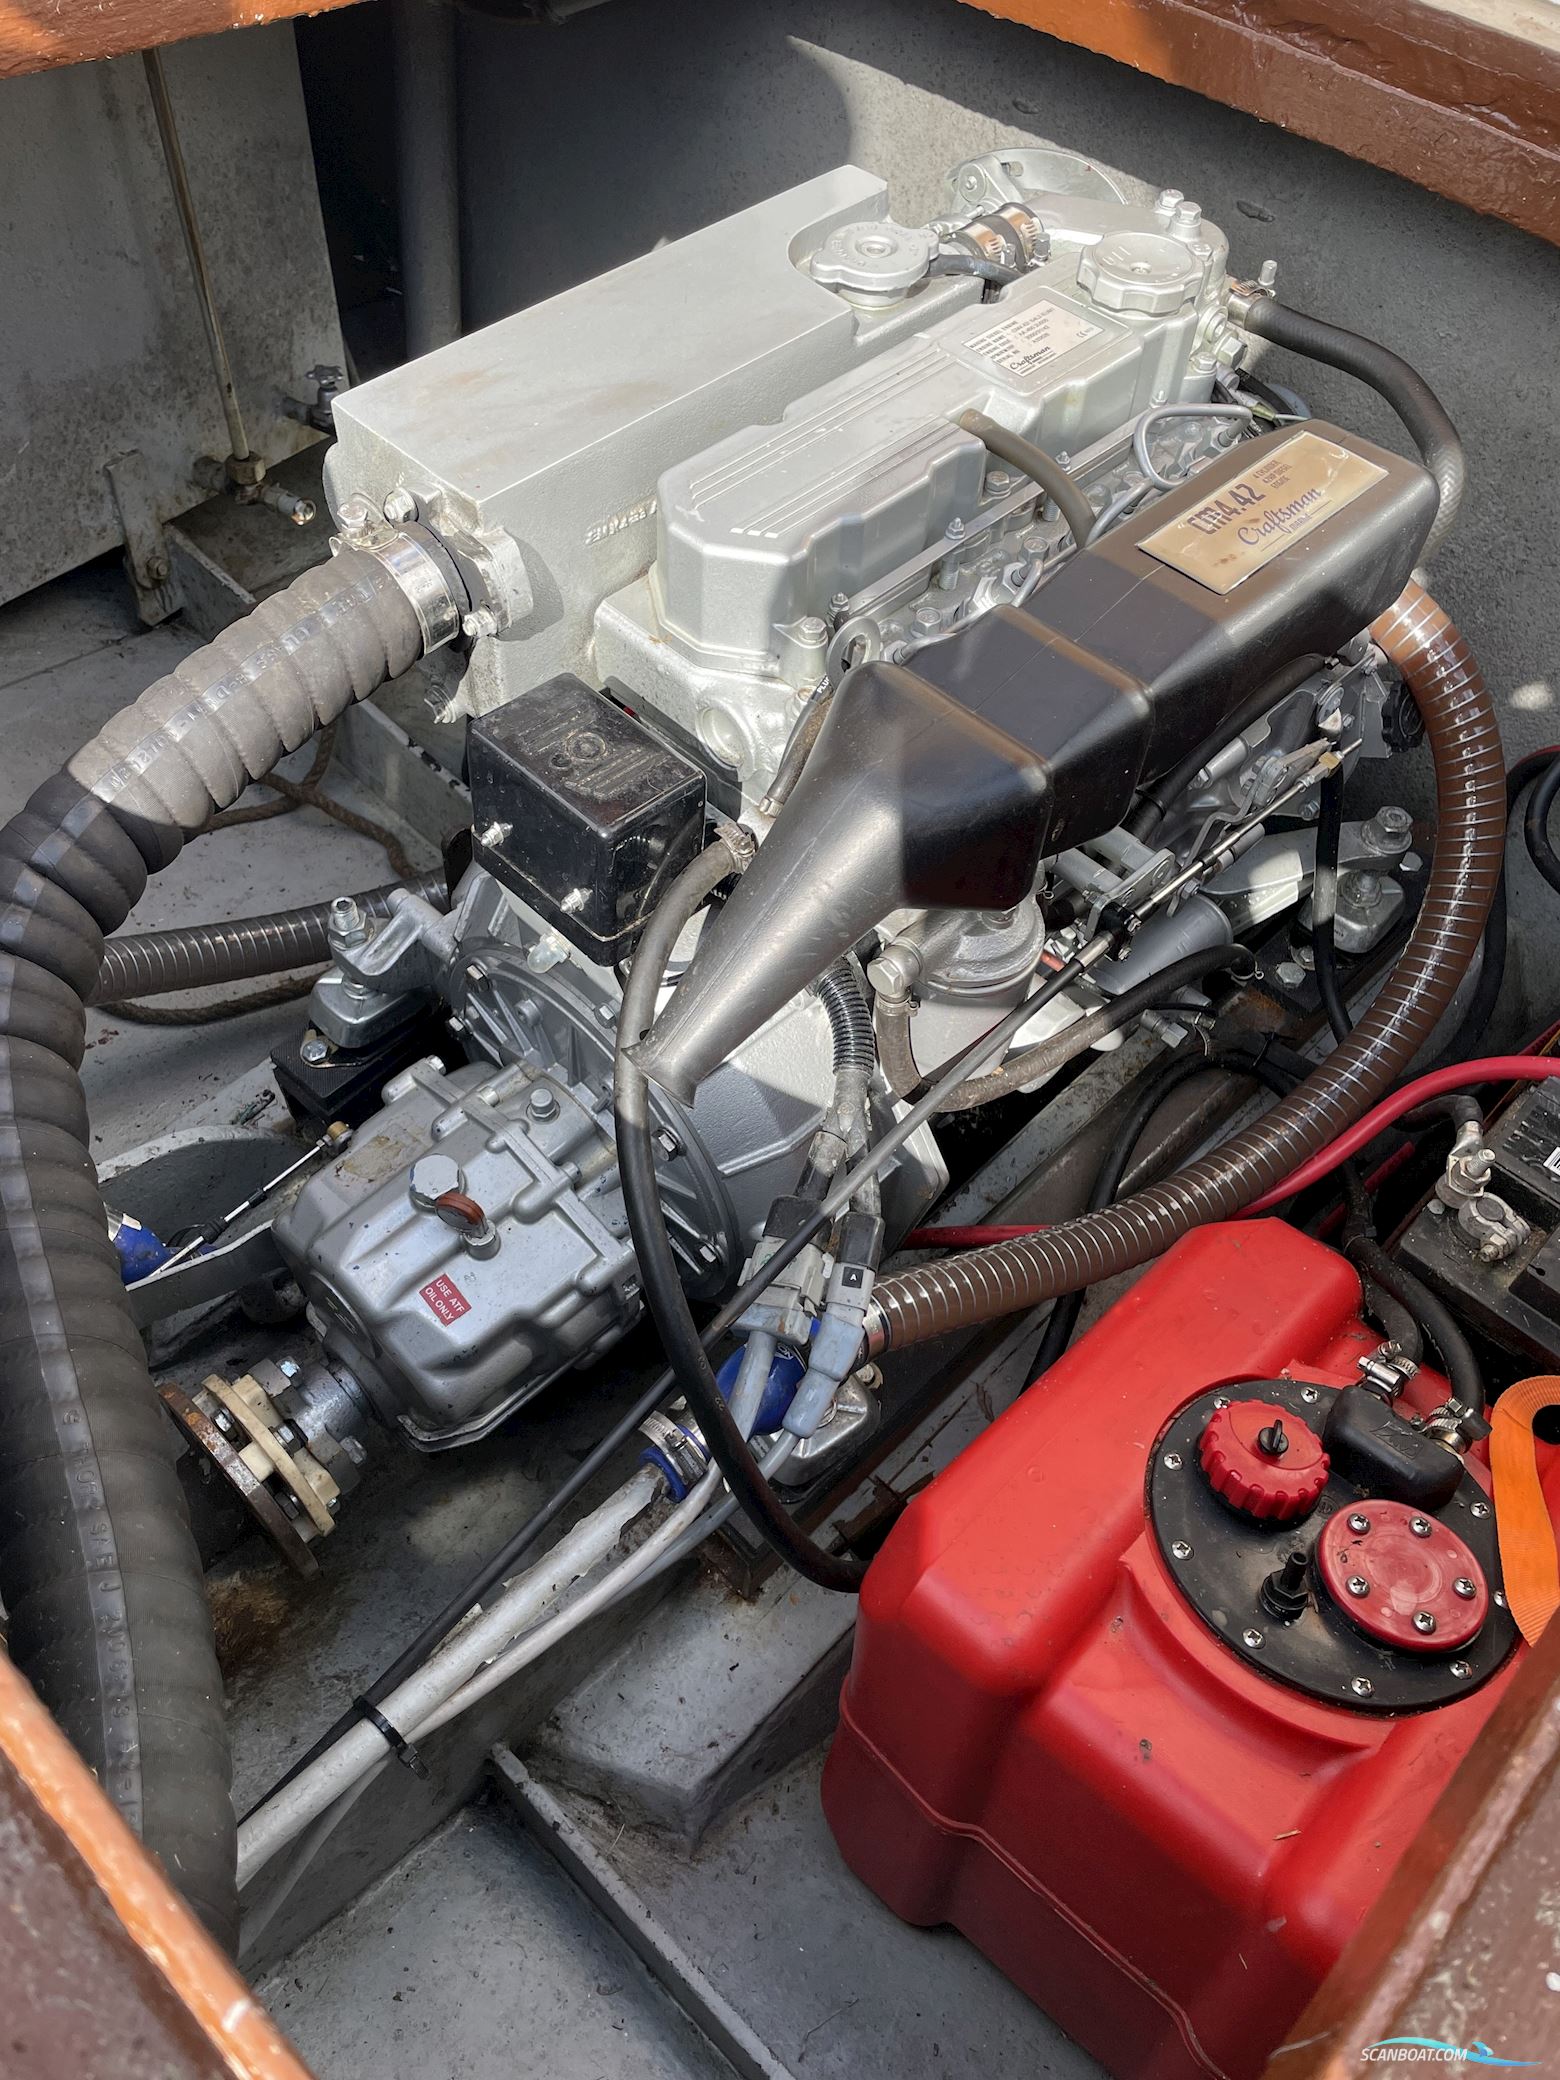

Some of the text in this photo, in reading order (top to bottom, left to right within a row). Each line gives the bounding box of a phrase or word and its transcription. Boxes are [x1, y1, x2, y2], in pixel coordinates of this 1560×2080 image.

[1009, 345, 1050, 370] Craftsman
[1257, 459, 1280, 477] CYLINDER
[1237, 487, 1322, 545] Craftsman
[850, 1273, 857, 1281] A
[425, 1287, 454, 1320] OIL ONLY
[436, 1280, 465, 1312] USE ATF
